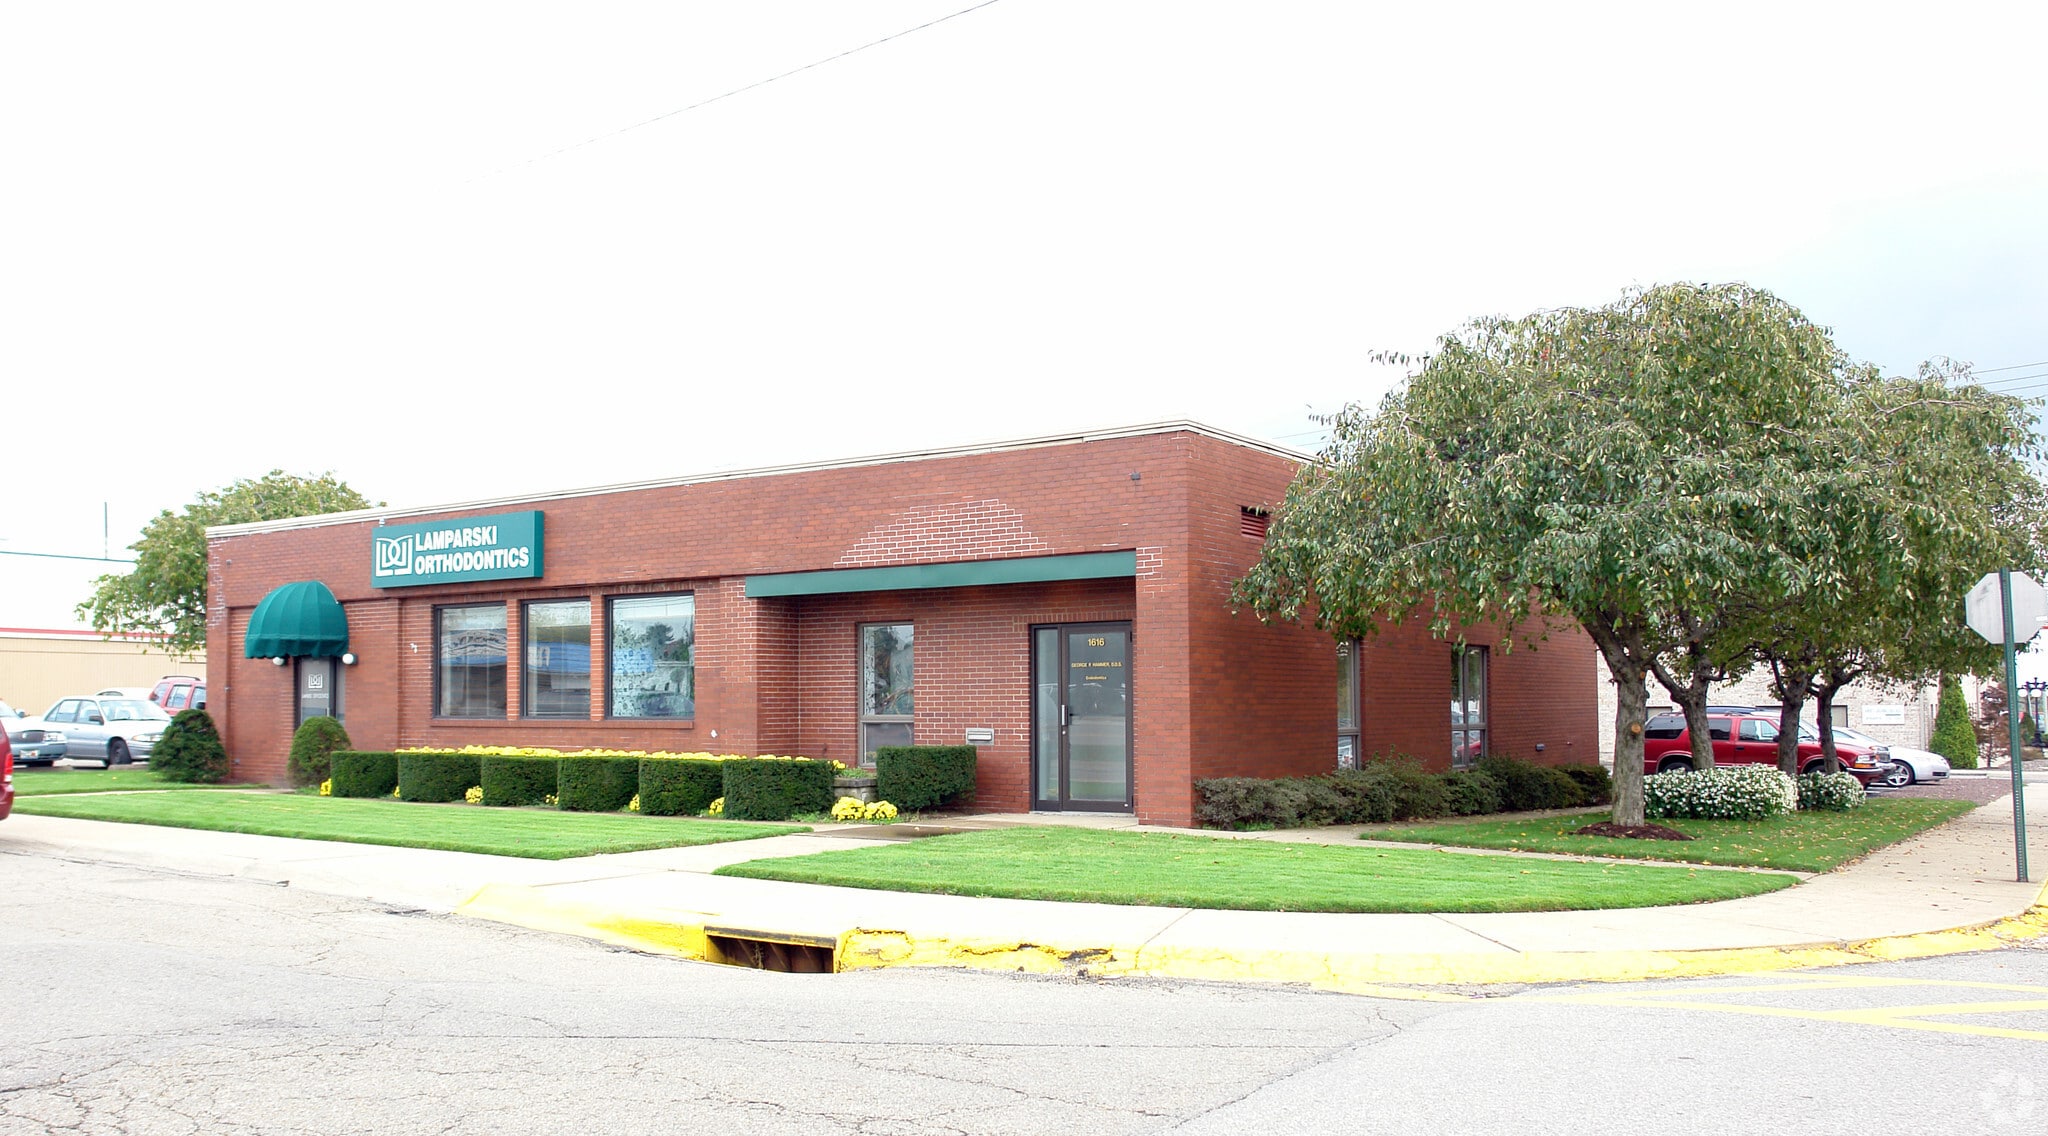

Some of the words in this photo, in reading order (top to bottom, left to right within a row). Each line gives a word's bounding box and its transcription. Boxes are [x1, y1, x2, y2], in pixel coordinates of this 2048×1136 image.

[415, 525, 498, 551] LAMPARSKI
[414, 547, 530, 575] ORTHODONTICS
[1087, 637, 1105, 647] 1616
